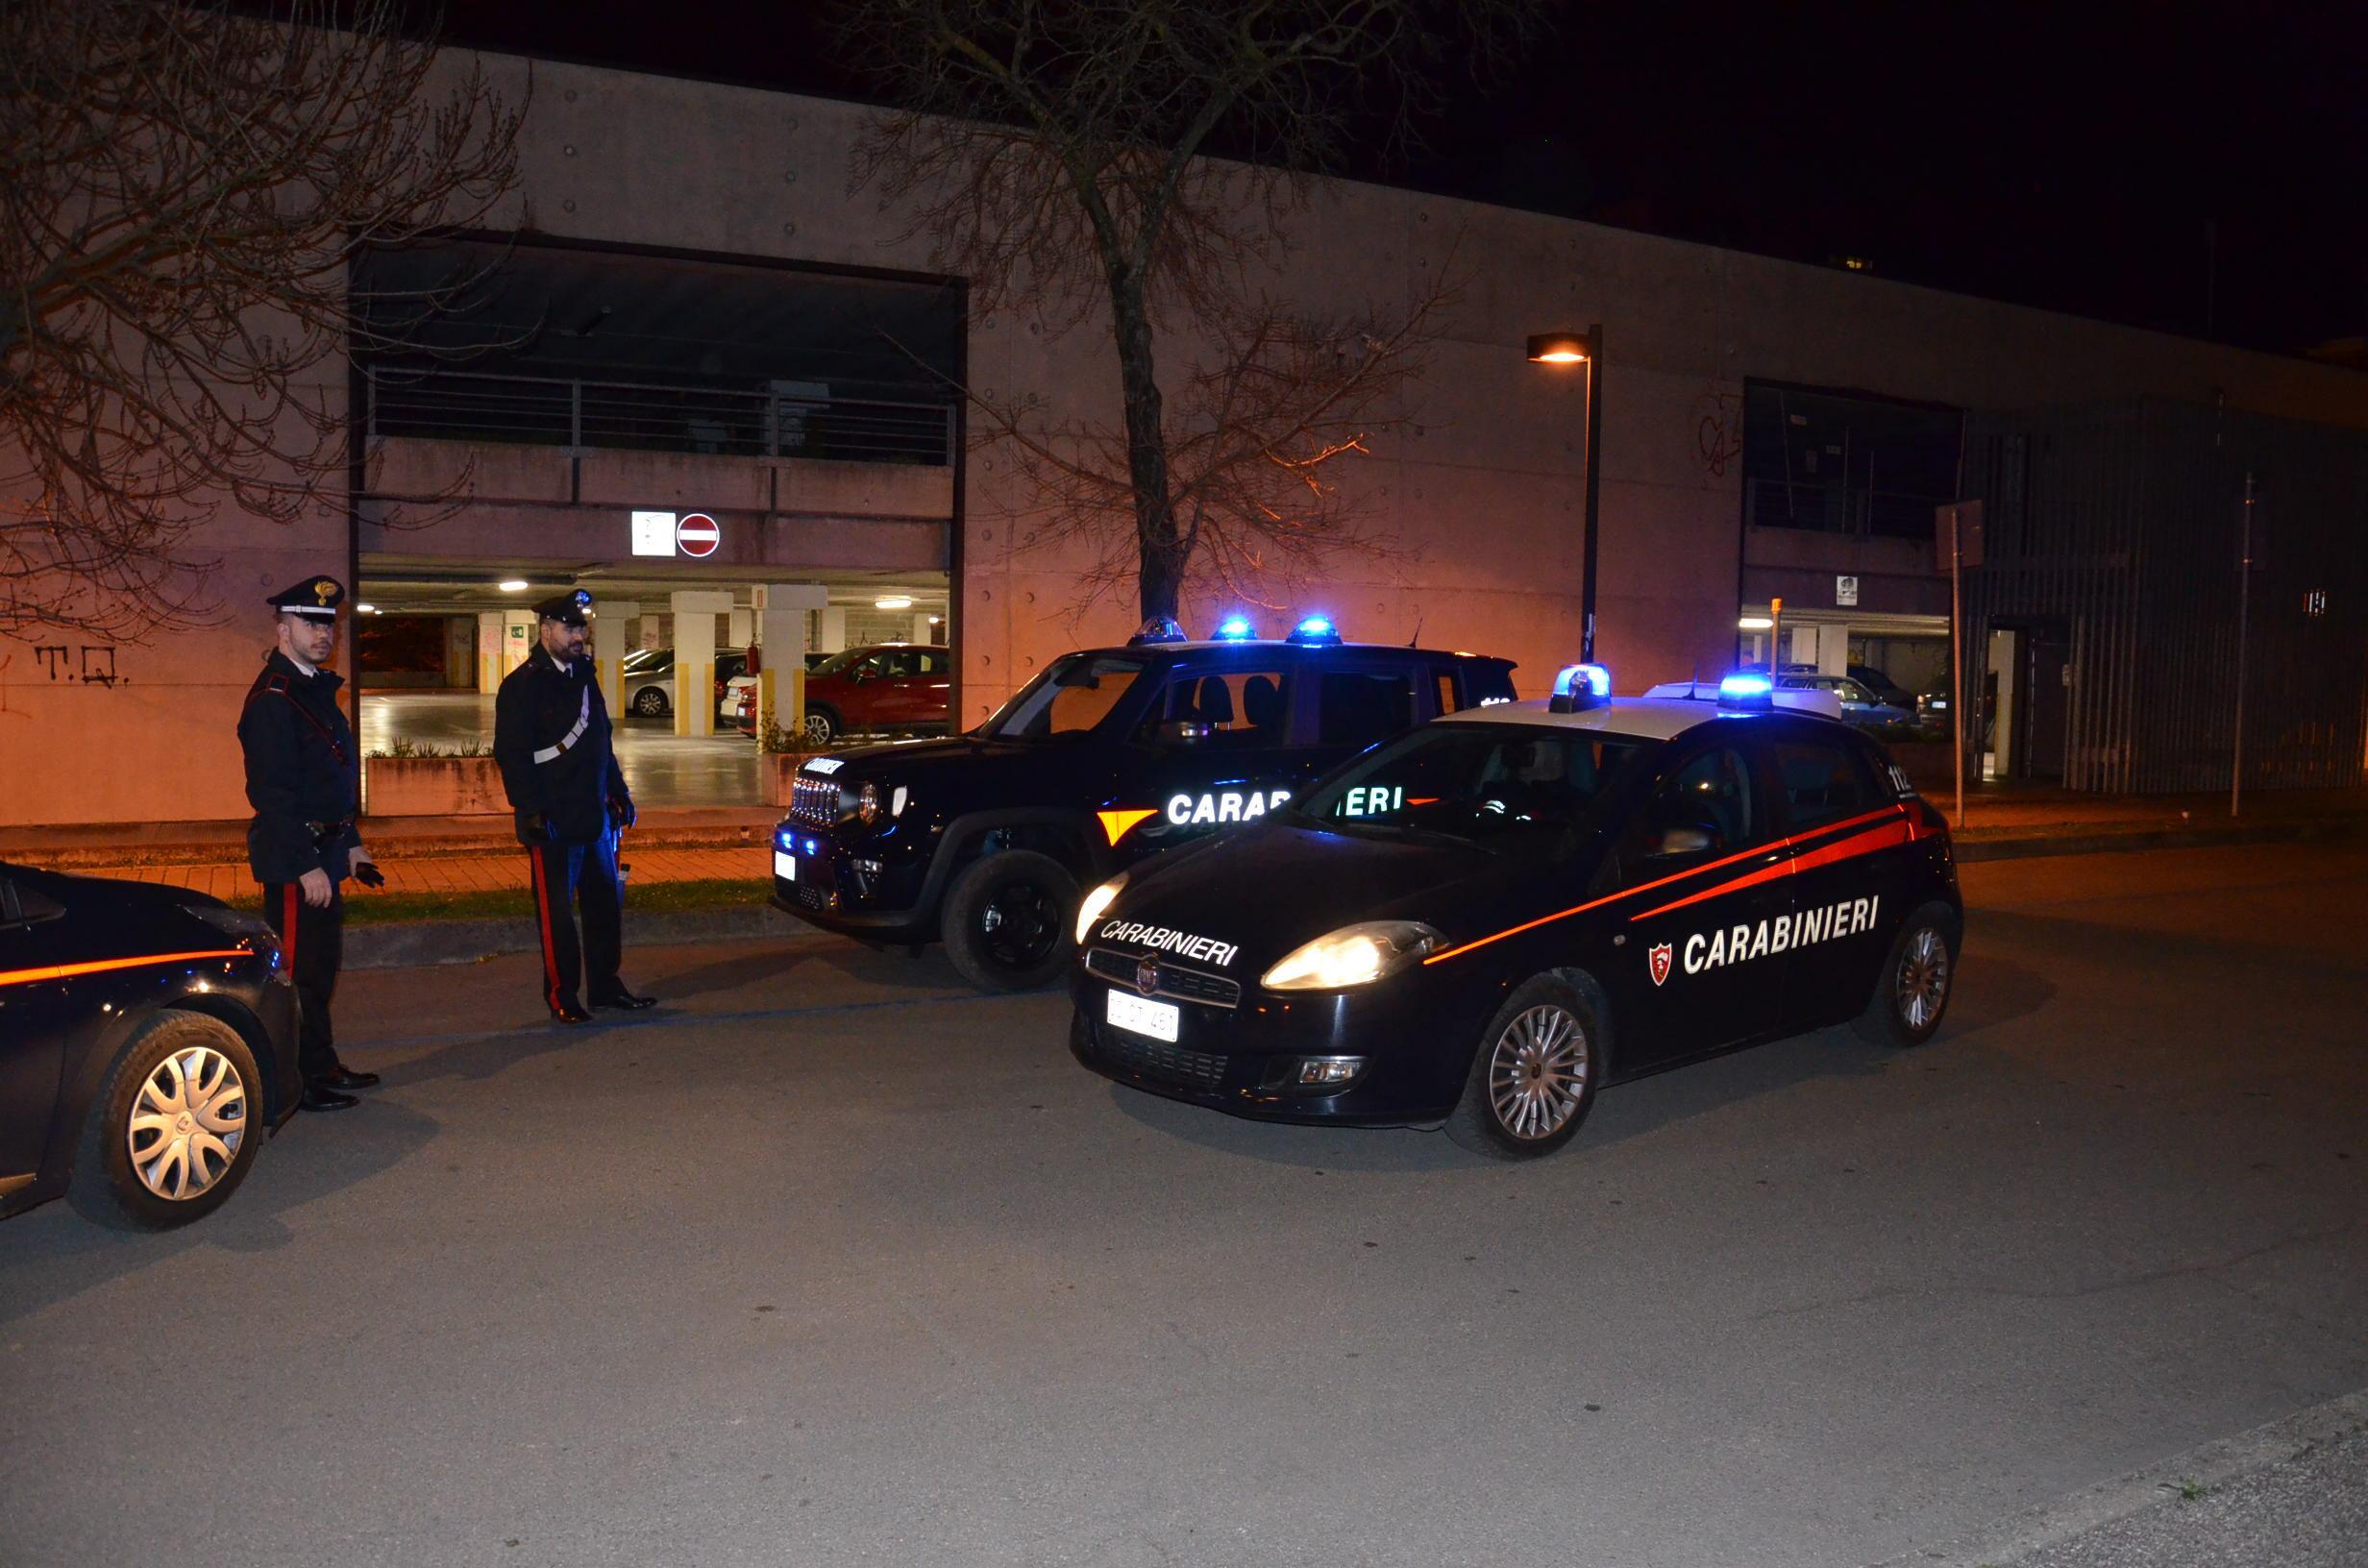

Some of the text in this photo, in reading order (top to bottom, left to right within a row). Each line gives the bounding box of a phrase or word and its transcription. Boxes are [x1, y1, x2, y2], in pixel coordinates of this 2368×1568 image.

[1168, 787, 1402, 824] CARAERI
[1100, 920, 1239, 967] CARABINIERI
[1684, 894, 1880, 974] CARABINIERI
